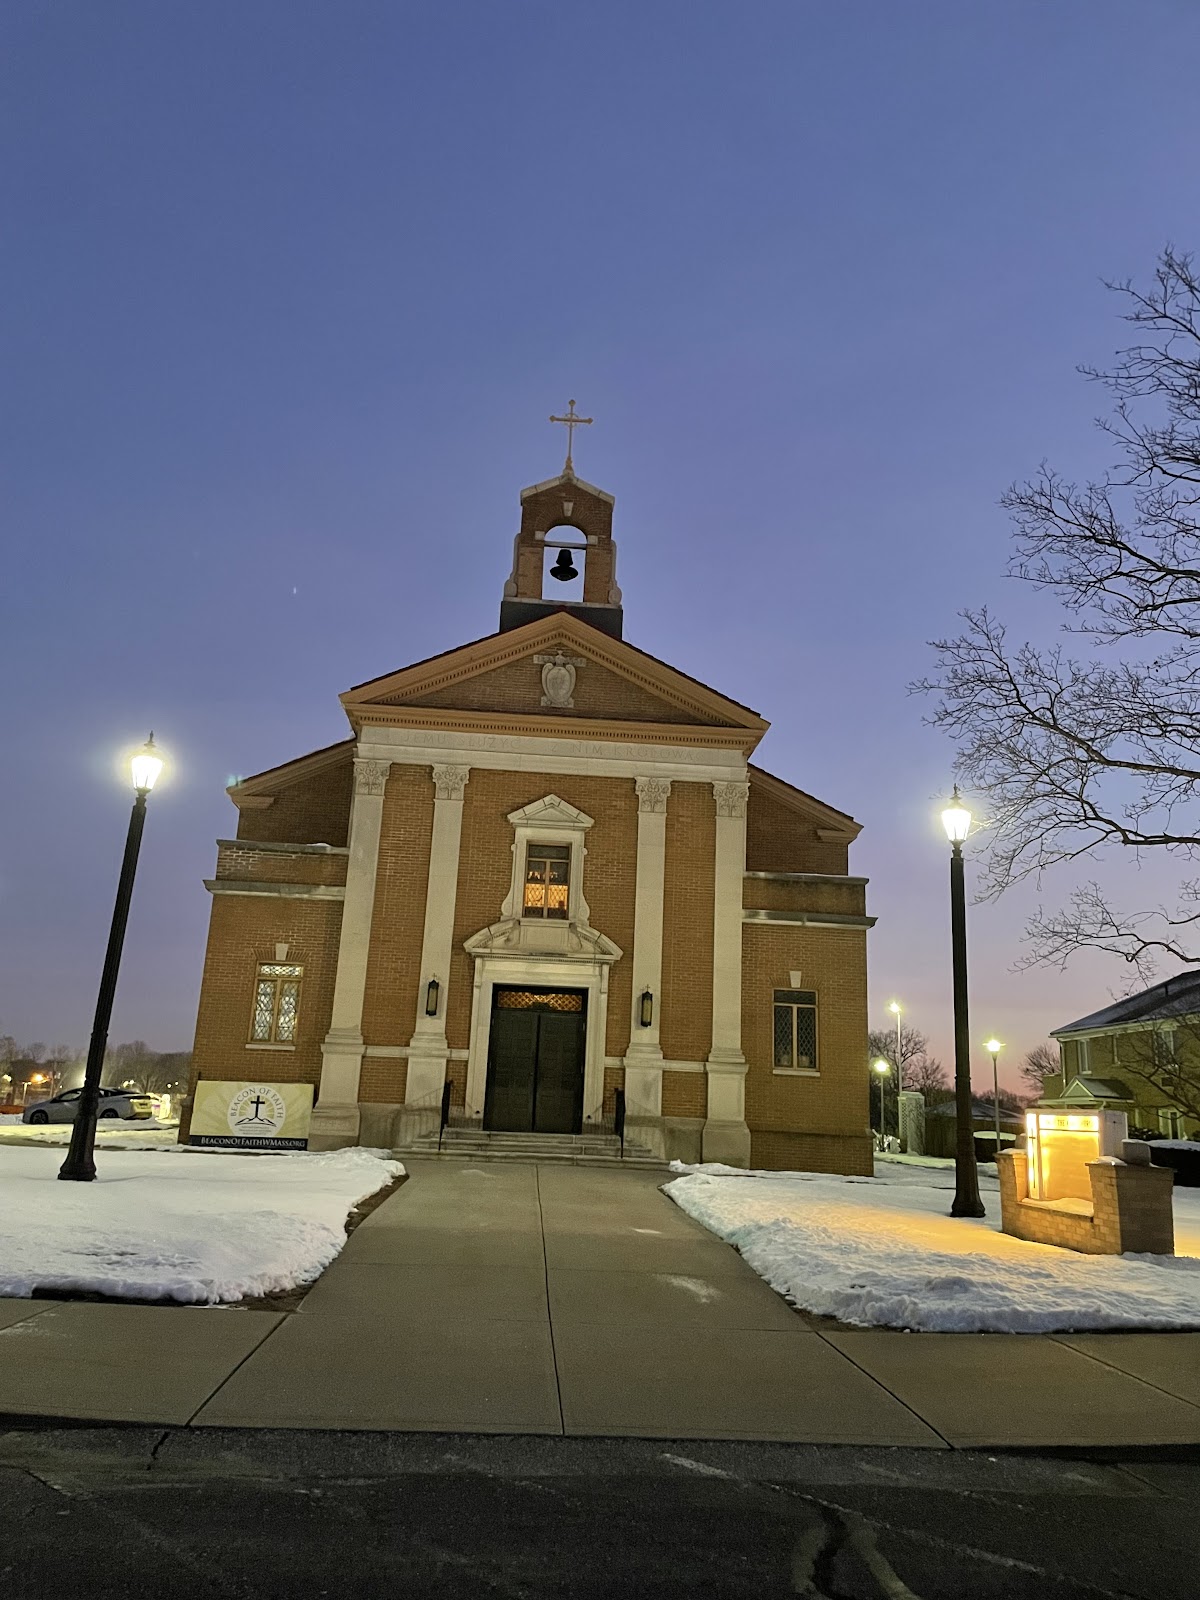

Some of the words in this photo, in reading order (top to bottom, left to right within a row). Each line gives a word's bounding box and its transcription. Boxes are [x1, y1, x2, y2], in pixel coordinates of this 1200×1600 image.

[572, 741, 603, 755] NIM
[230, 1087, 256, 1117] BEACON
[259, 1087, 271, 1096] OF
[271, 1093, 284, 1118] FAITH
